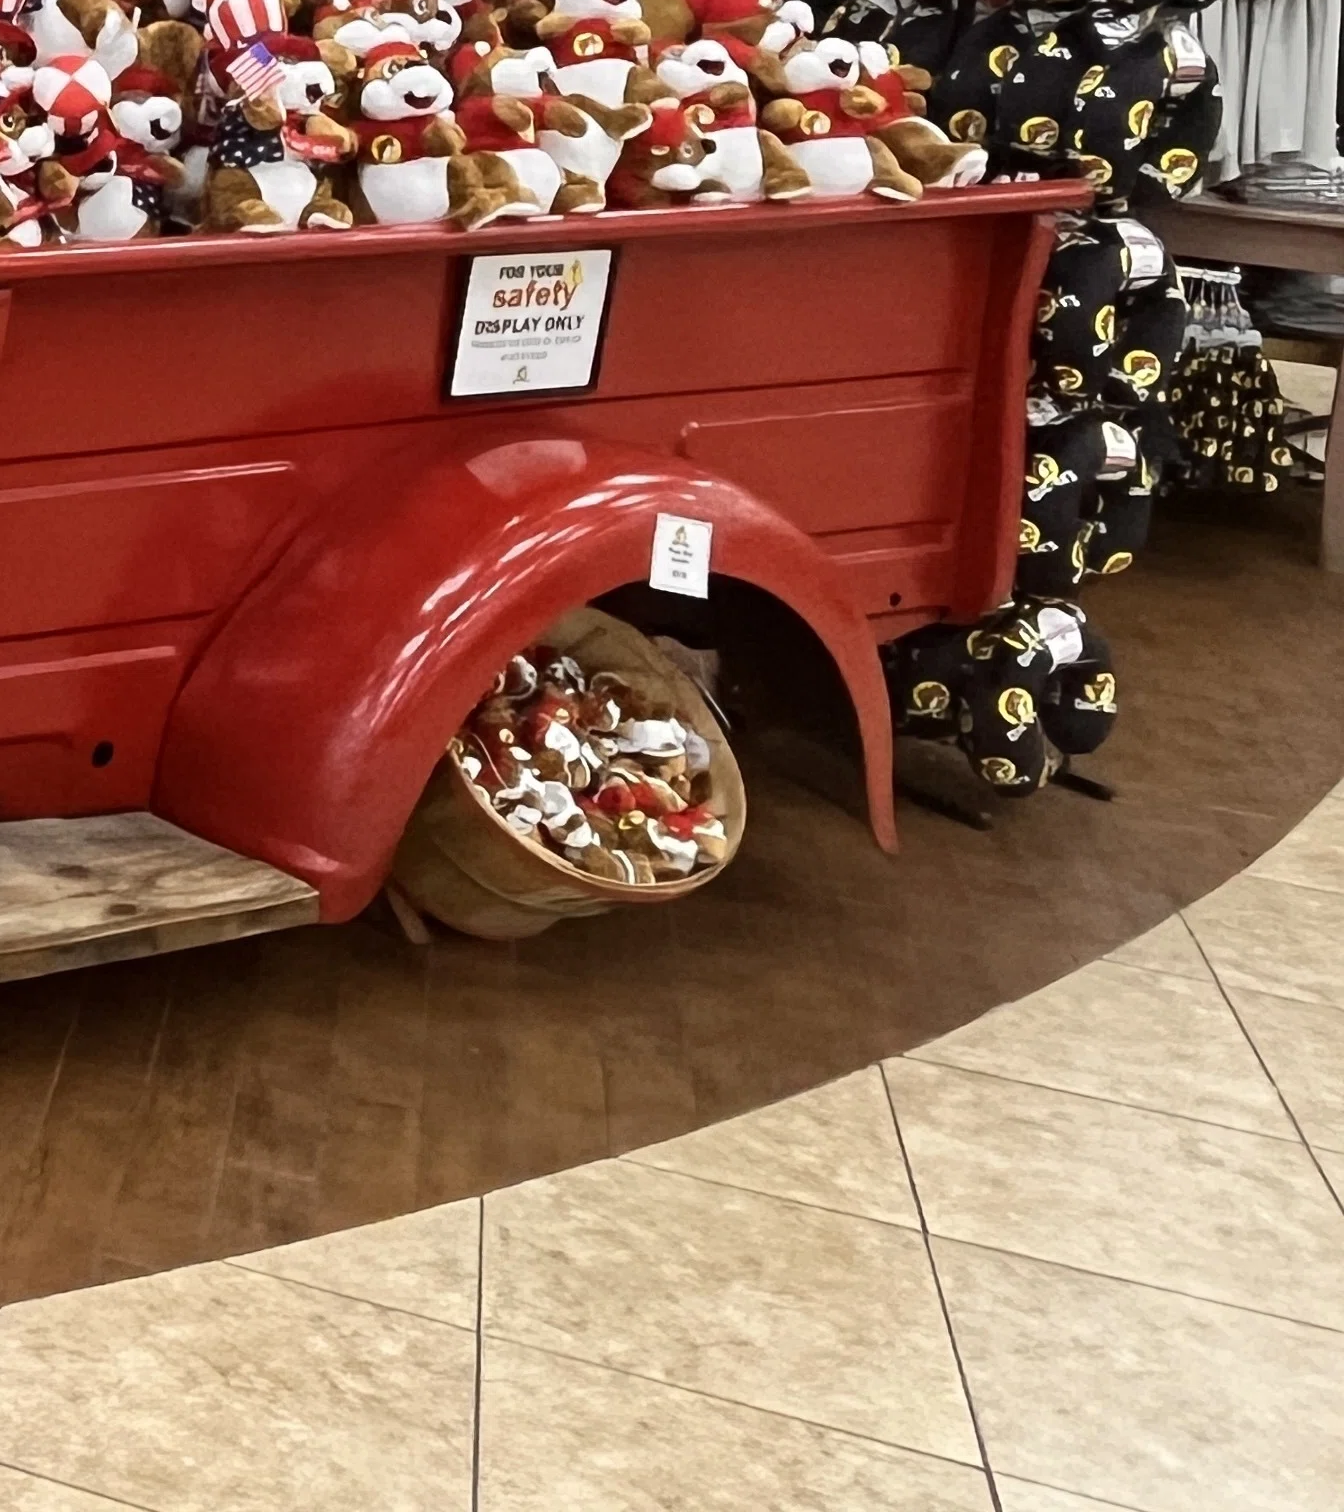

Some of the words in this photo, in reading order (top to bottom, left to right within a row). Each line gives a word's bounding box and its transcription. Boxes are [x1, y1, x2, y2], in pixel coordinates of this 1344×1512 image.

[492, 279, 577, 311] safety
[474, 316, 542, 335] DISPLAY
[544, 314, 584, 332] ONLY
